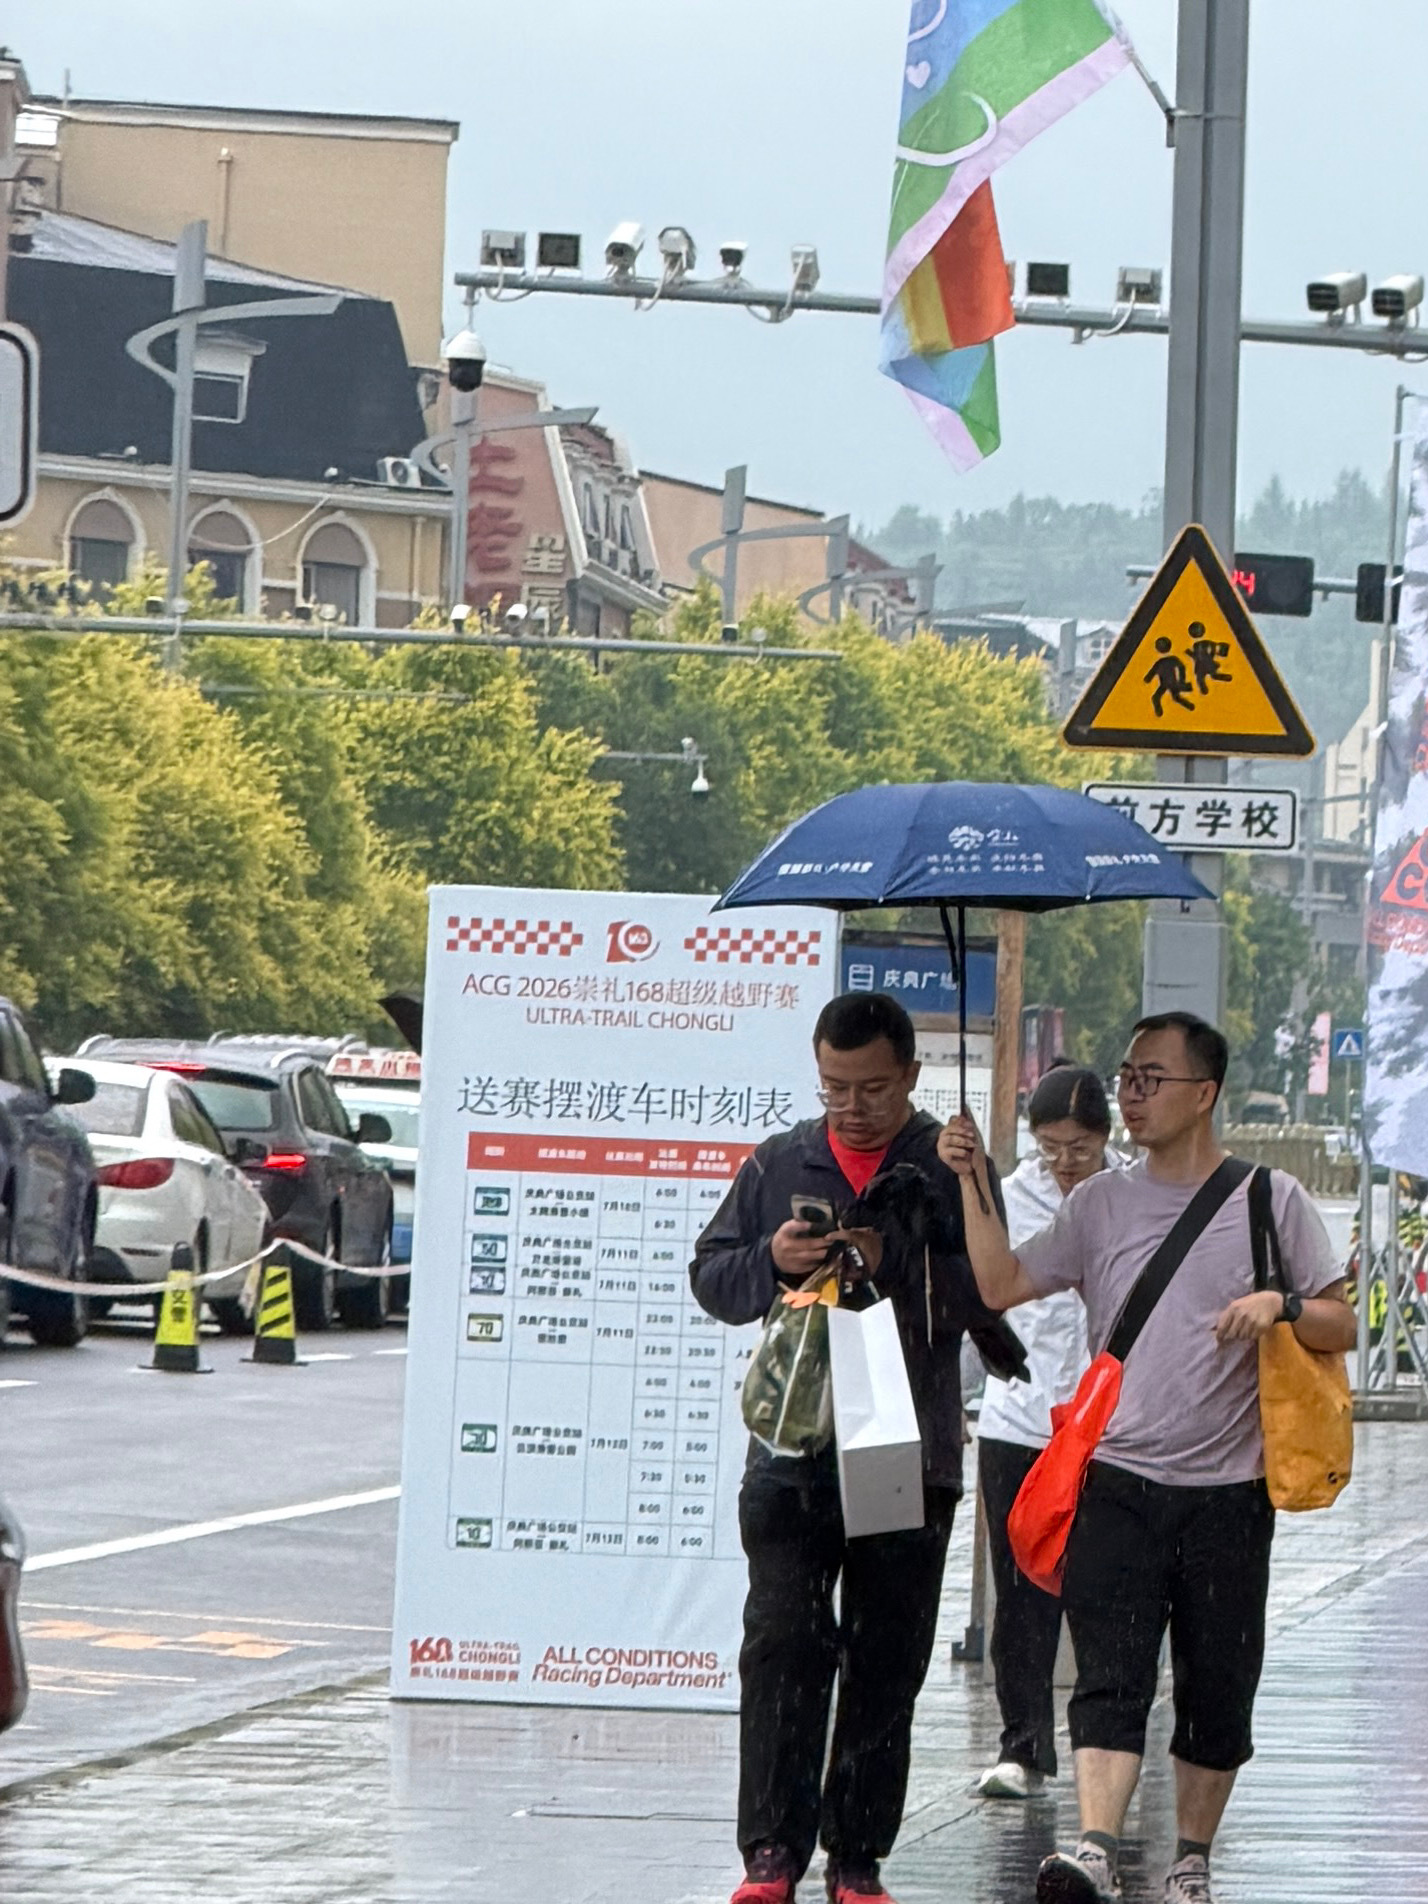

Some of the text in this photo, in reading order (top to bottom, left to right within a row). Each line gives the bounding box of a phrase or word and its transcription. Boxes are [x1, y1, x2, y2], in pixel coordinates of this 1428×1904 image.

[462, 973, 510, 996] ACG
[526, 1006, 734, 1032] ULTRA-TRAIL CHONGLI
[456, 1076, 793, 1128] 送赛摆渡车时刻表
[458, 1650, 521, 1665] CHONGLI
[543, 1646, 718, 1669] ALL CONDITIONS
[532, 1664, 726, 1688] Racing Department
